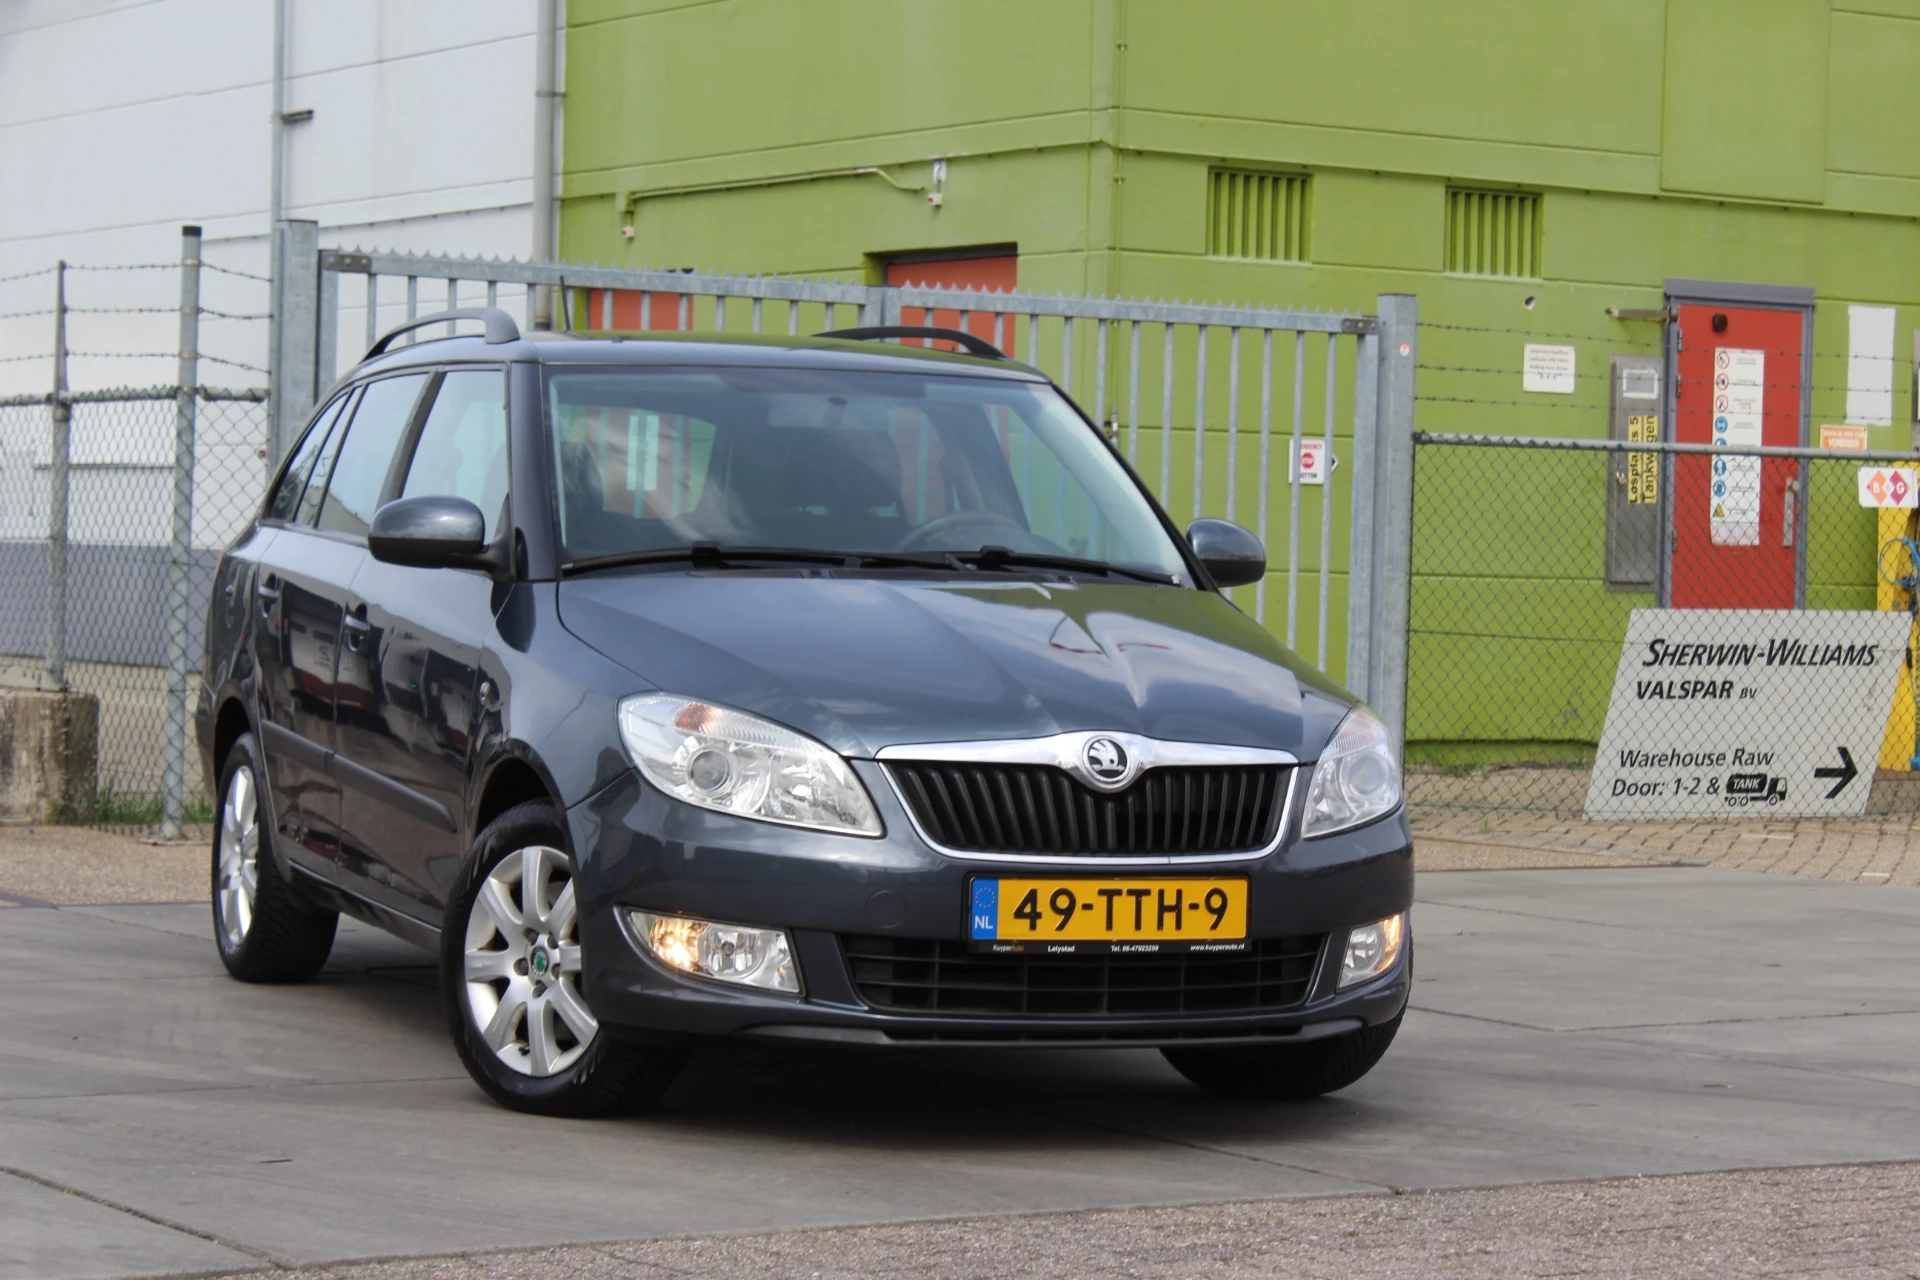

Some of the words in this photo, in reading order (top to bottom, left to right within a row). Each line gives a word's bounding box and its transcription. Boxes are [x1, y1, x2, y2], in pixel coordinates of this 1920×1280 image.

[1629, 416, 1639, 425] 5
[1642, 415, 1658, 503] Tankwgen
[1641, 638, 1879, 667] SHERWIN-WILLIAMS
[1636, 680, 1734, 700] VALSPAR
[1739, 687, 1758, 699] BV
[1619, 748, 1727, 768] Warehouse
[1731, 747, 1775, 767] Raw
[1611, 778, 1666, 797] Door:
[1673, 777, 1701, 796] 1-2
[1706, 777, 1721, 796] &
[1731, 777, 1761, 790] TANK
[1013, 888, 1229, 932] 49-TTH-9
[974, 915, 994, 930] NL
[1047, 944, 1076, 954] Lelystad
